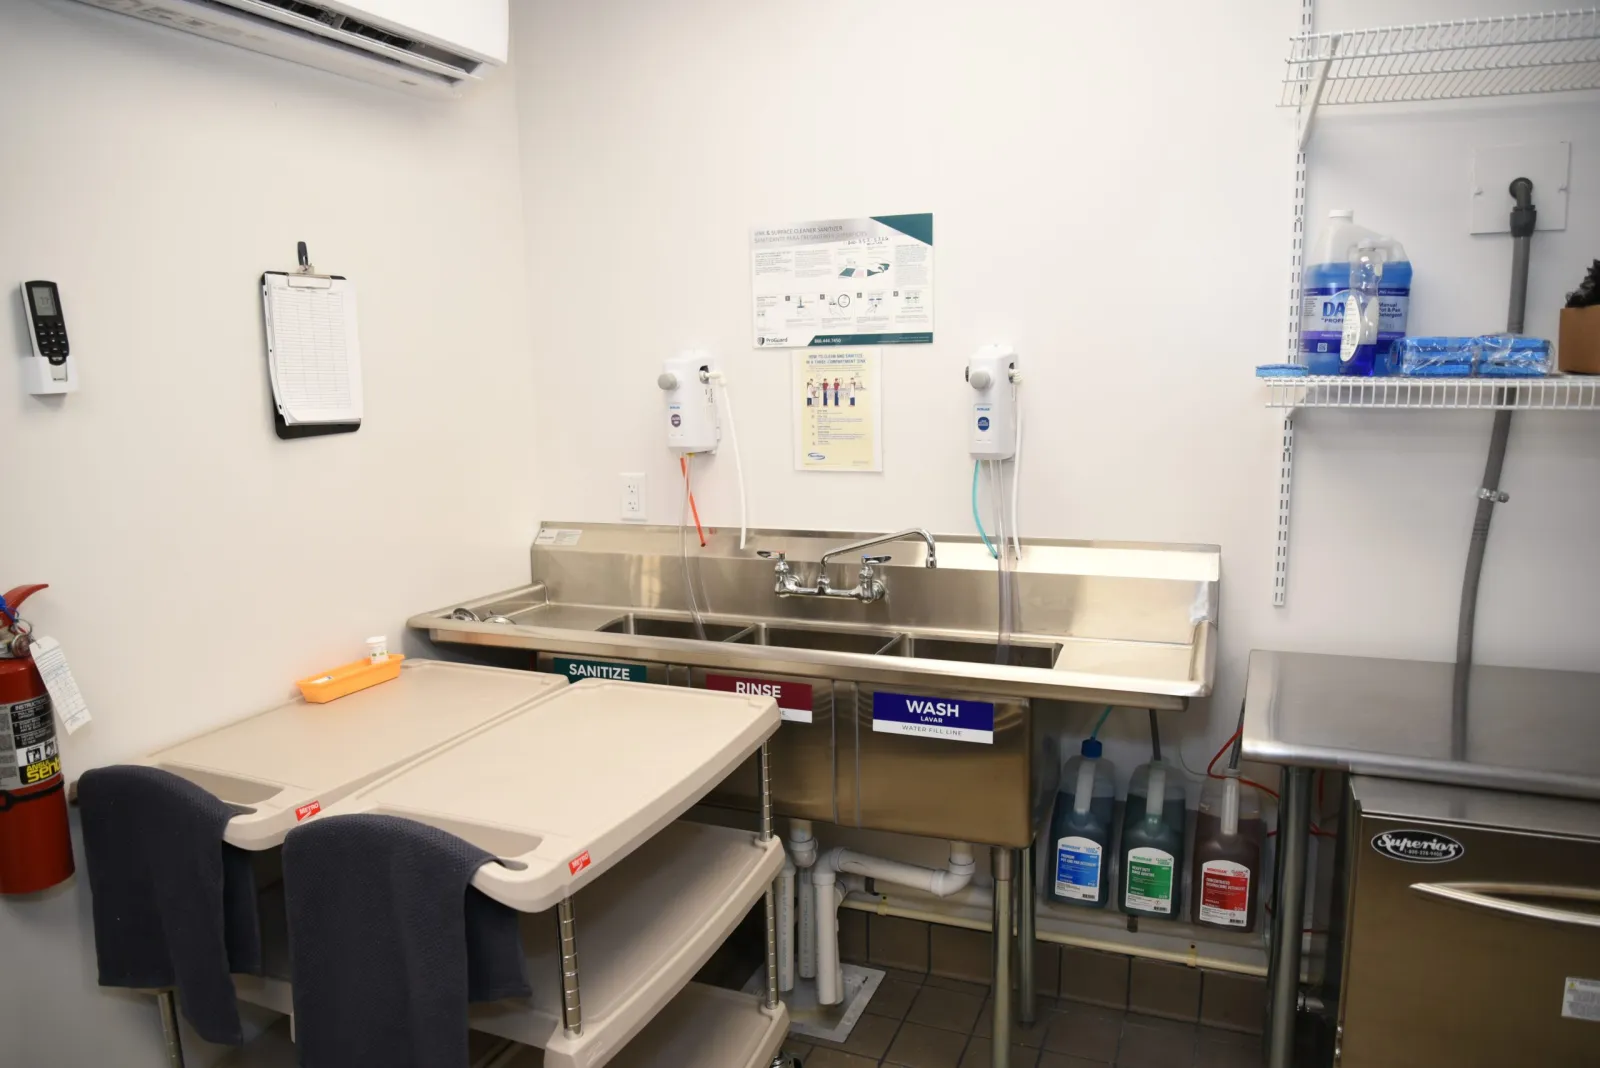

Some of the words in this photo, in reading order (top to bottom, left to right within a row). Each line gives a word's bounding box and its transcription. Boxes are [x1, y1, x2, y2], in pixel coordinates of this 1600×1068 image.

[1323, 302, 1345, 317] DA
[569, 663, 630, 680] SANITIZE
[735, 681, 782, 698] RINSE
[906, 699, 959, 717] WASH
[920, 715, 943, 724] LAVAR
[902, 724, 927, 732] WATER
[928, 726, 944, 734] FILL
[945, 728, 963, 736] LINE
[299, 803, 319, 814] METRO
[1377, 833, 1459, 857] Superior
